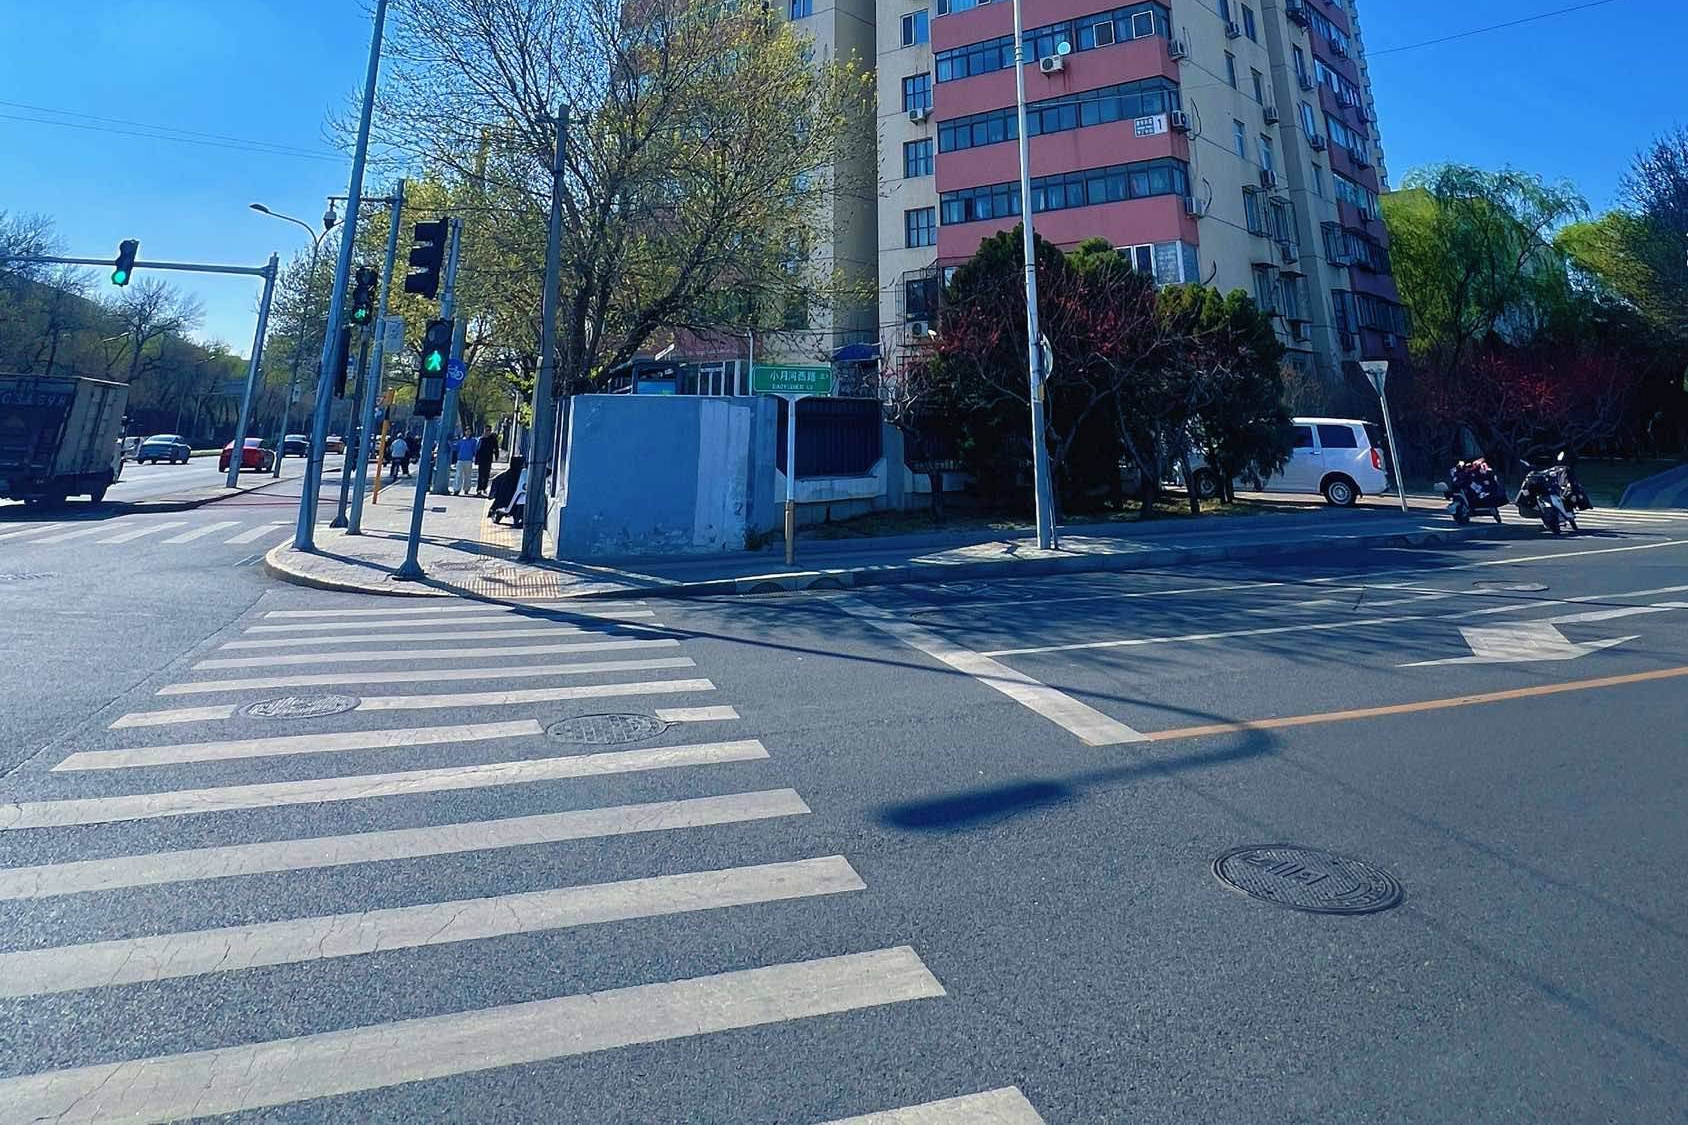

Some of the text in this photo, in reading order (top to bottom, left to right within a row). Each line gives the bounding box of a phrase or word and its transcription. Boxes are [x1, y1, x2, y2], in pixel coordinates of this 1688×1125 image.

[770, 370, 816, 381] 小月河西路
